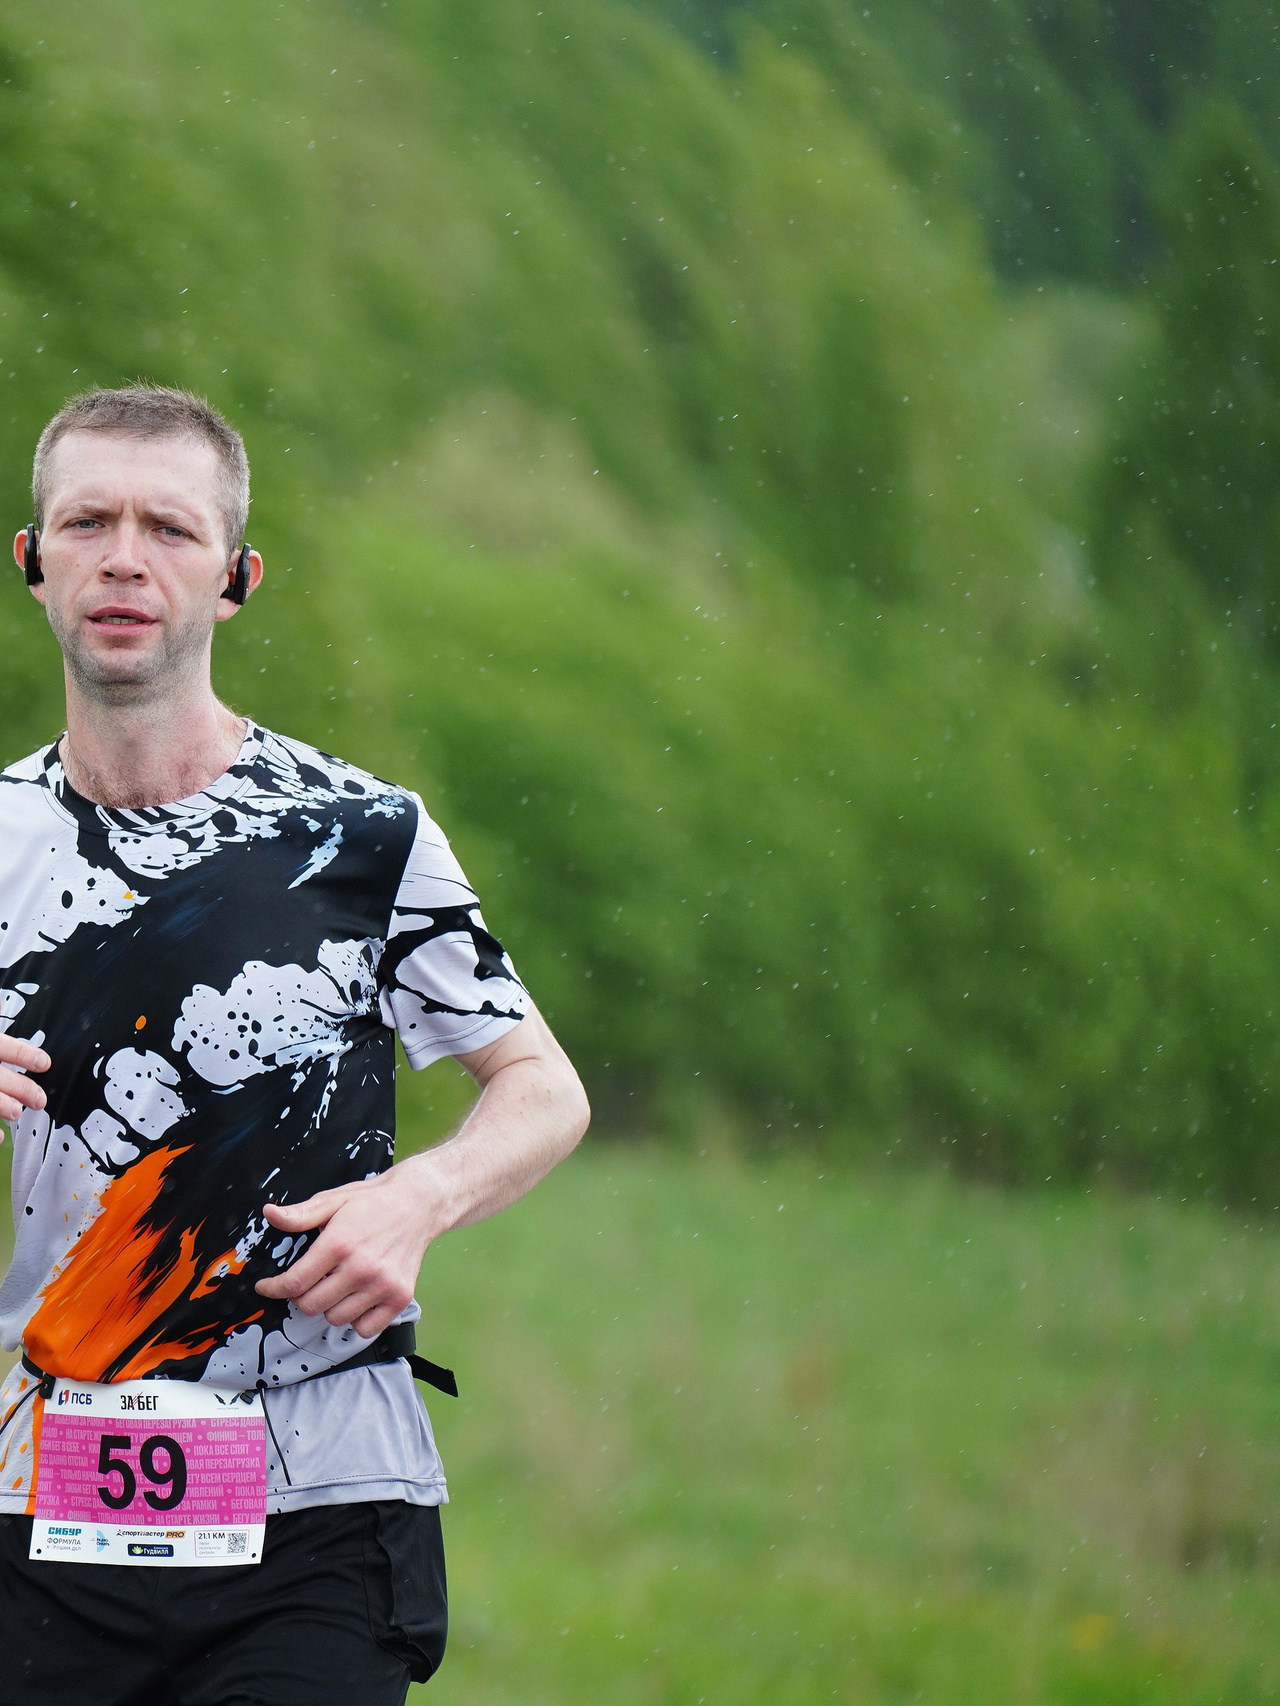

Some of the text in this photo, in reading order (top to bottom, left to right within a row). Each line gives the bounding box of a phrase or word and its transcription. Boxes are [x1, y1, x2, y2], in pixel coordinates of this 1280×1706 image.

[71, 1392, 93, 1405] ПСБ
[142, 1418, 197, 1429] ПЕРЕЗАГРУЗКА
[210, 1417, 240, 1428] СТРЕСС
[206, 1430, 238, 1442] ФИНИШ
[193, 1445, 215, 1456] ПОКА
[215, 1444, 229, 1455] ВСЕ
[229, 1444, 250, 1455] СПЯТ
[205, 1457, 261, 1469] ПЕРЕЗАГРУЗКА
[97, 1435, 187, 1511] 59
[200, 1473, 222, 1484] ВСЕМ
[222, 1472, 257, 1485] СЕРДЦЕМ
[235, 1486, 256, 1497] ПОКА
[192, 1500, 218, 1510] РАМКИ
[155, 1514, 166, 1525] НА
[165, 1514, 192, 1525] СТАРТЕ
[192, 1514, 220, 1525] ЖИЗНИ
[47, 1526, 82, 1536] СИБУР
[46, 1537, 82, 1546] ФОРМУЛА
